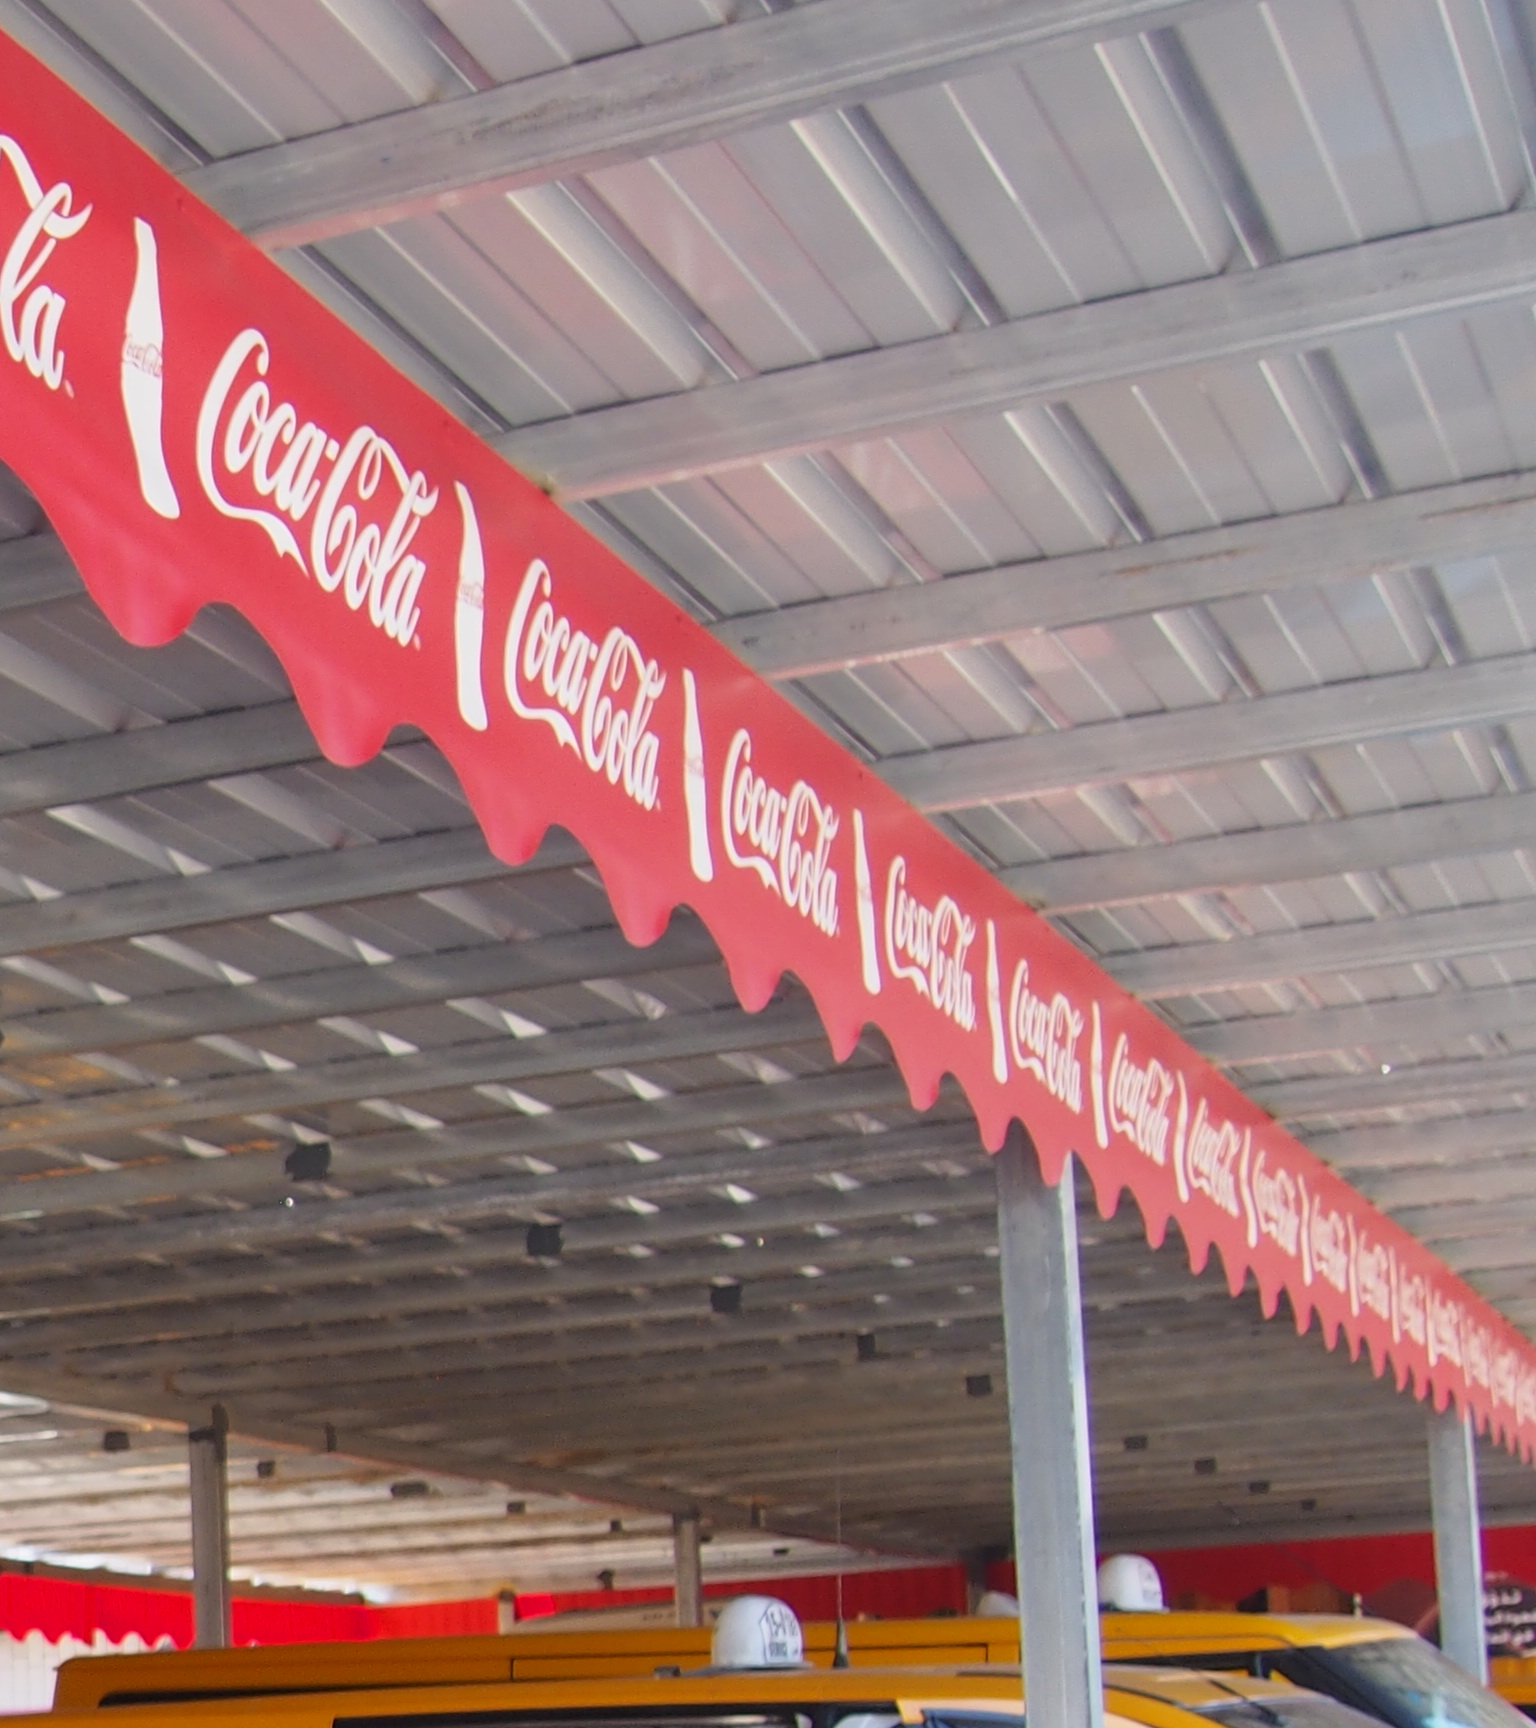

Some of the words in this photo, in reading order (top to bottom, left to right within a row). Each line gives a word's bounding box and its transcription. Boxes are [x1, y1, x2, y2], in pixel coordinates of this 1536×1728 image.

[197, 329, 438, 648] Coca-Cola
[505, 559, 665, 810] Coca-Cola
[722, 729, 839, 936] Coca-Cola
[886, 855, 976, 1031] Coca-Cola
[1010, 960, 1083, 1114] Coca-Cola
